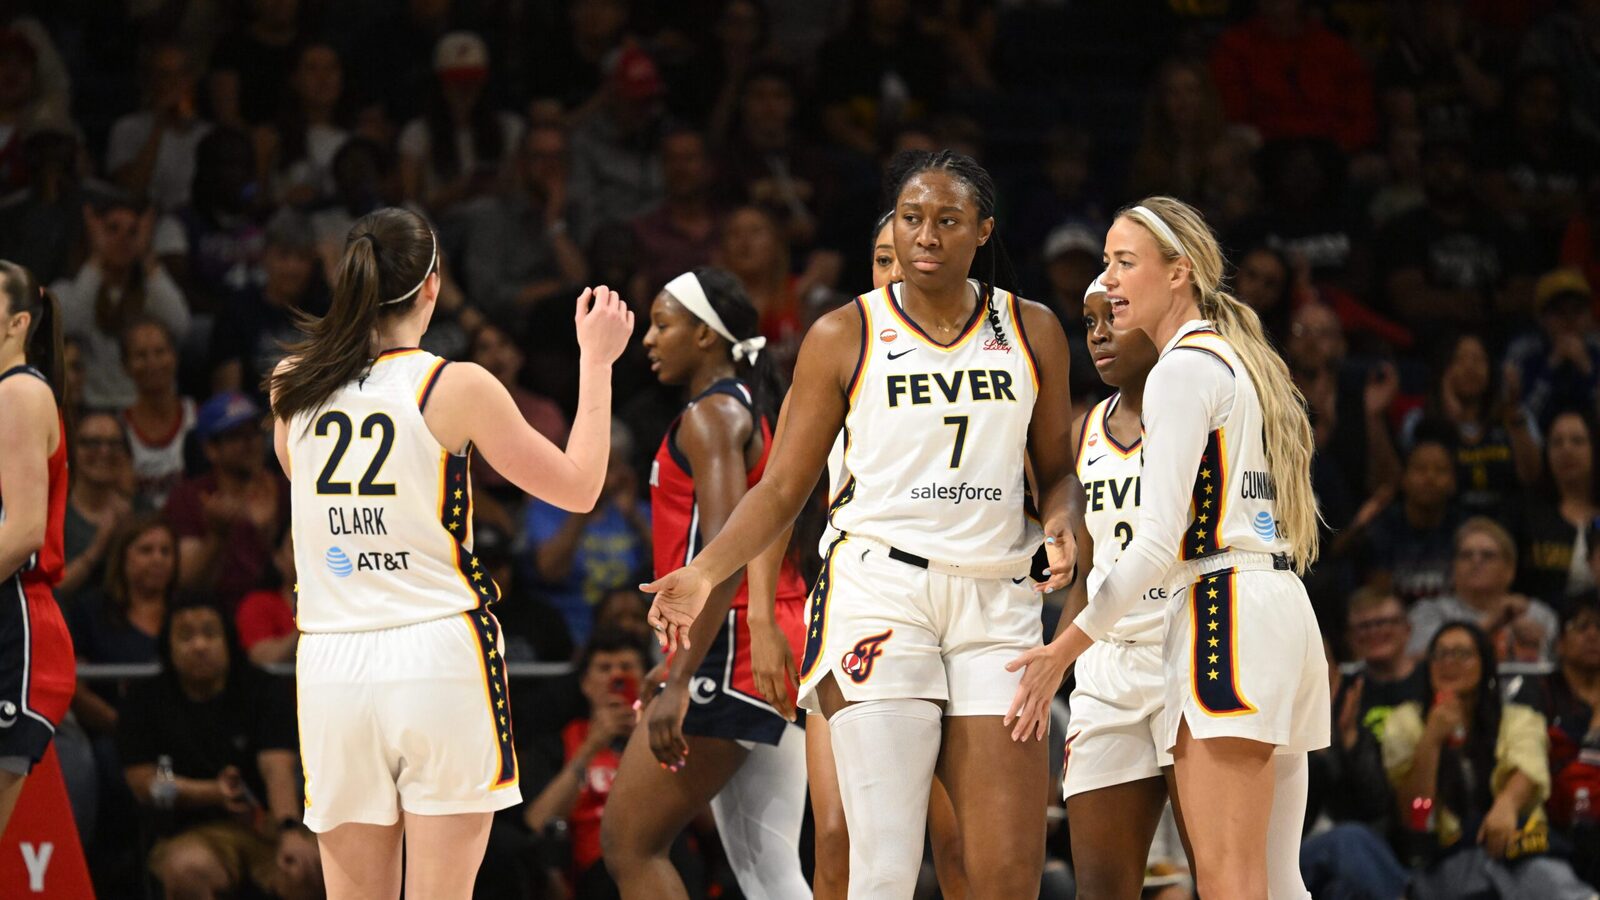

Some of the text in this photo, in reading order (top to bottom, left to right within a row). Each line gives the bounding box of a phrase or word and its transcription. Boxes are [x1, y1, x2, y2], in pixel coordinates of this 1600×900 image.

[886, 369, 1018, 408] FEVER
[315, 410, 397, 495] 22
[943, 415, 970, 469] 7
[910, 482, 1002, 504] salesforce
[328, 506, 388, 536] CLARK
[357, 551, 410, 572] AT&T
[19, 842, 54, 892] Y
